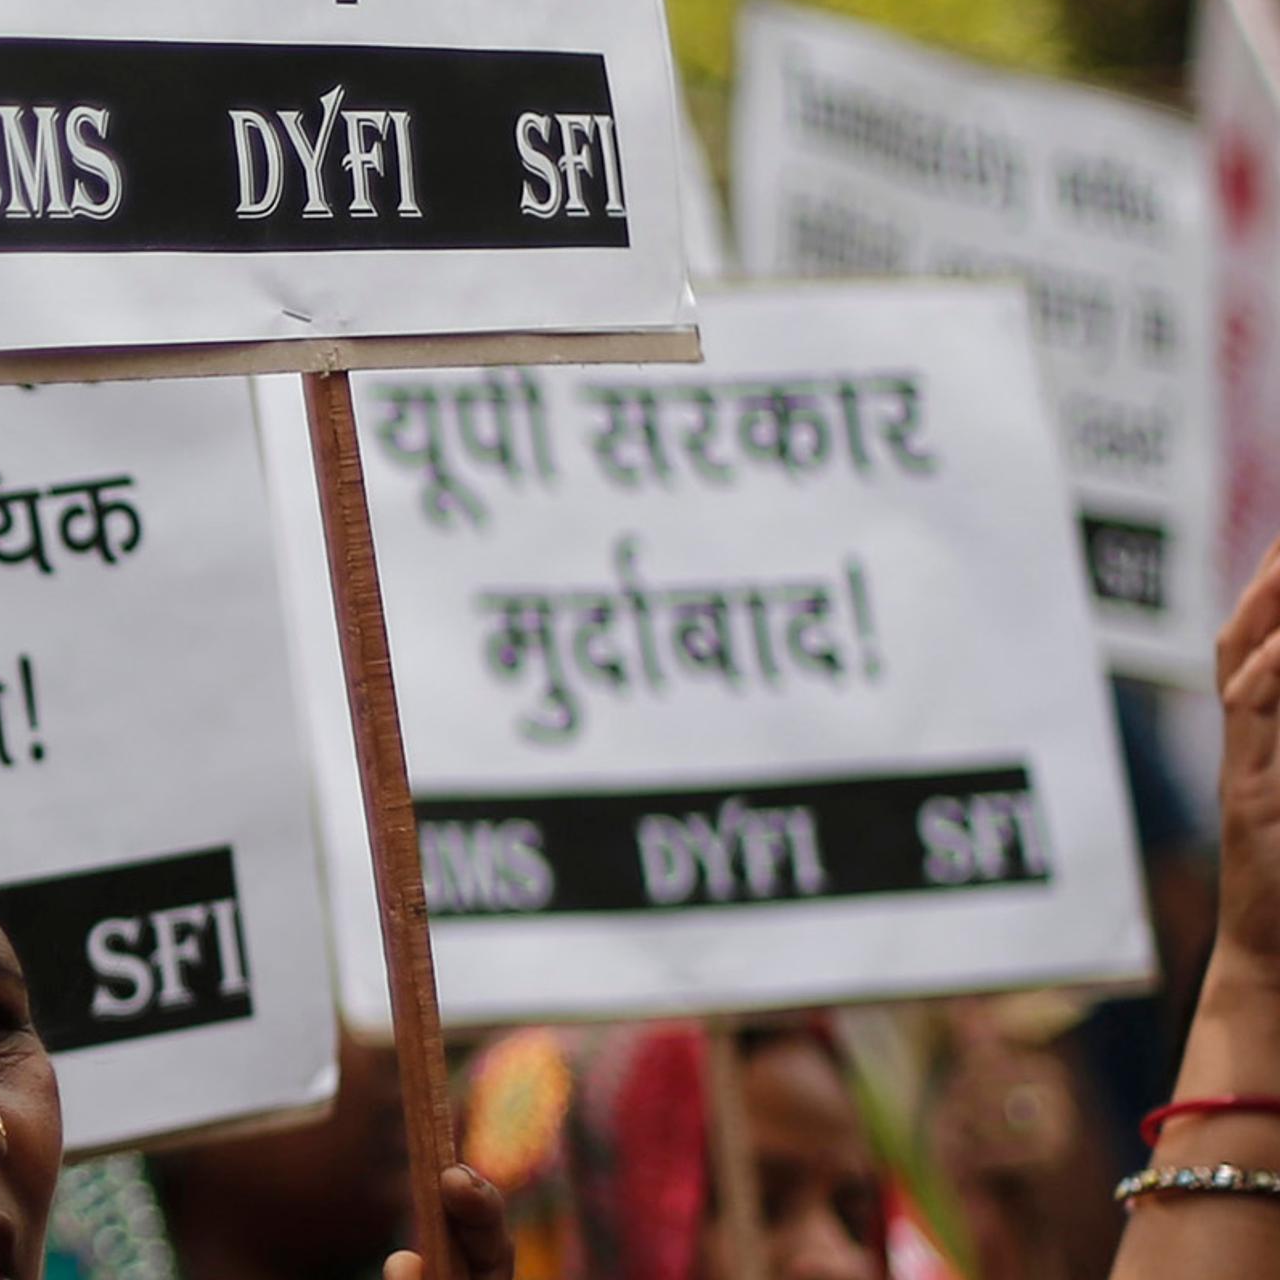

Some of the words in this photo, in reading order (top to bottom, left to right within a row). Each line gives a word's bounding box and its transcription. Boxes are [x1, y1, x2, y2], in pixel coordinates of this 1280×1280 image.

[231, 86, 422, 221] DYFI
[515, 112, 627, 219] SFI
[575, 372, 946, 484] सरकार
[637, 795, 826, 906] DYFI
[86, 897, 250, 1018] SFI
